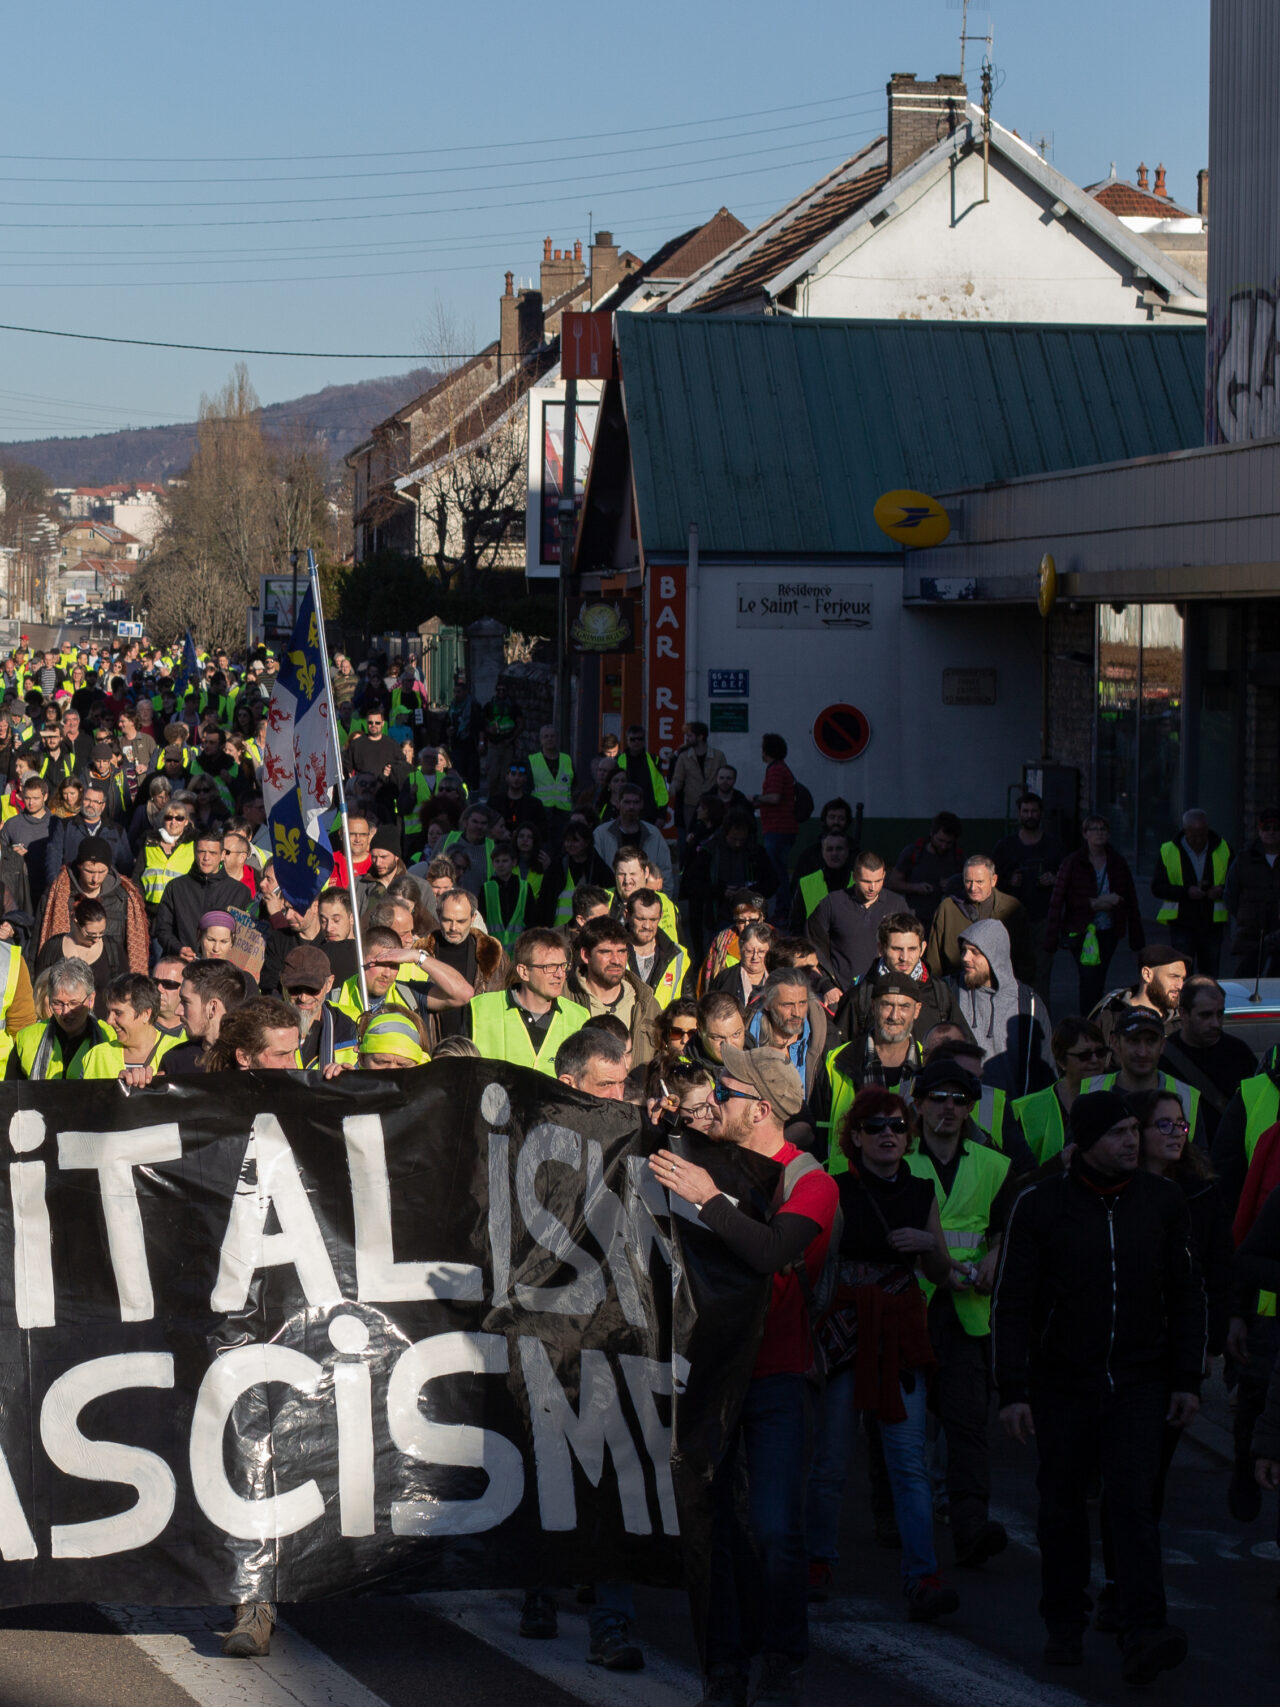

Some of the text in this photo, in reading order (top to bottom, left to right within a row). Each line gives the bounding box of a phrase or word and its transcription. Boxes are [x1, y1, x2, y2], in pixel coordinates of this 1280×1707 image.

[778, 583, 832, 597] Résidence
[656, 575, 680, 659] BAR
[739, 597, 756, 613] Le
[761, 597, 799, 616] Saint
[815, 599, 871, 618] Ferjeux
